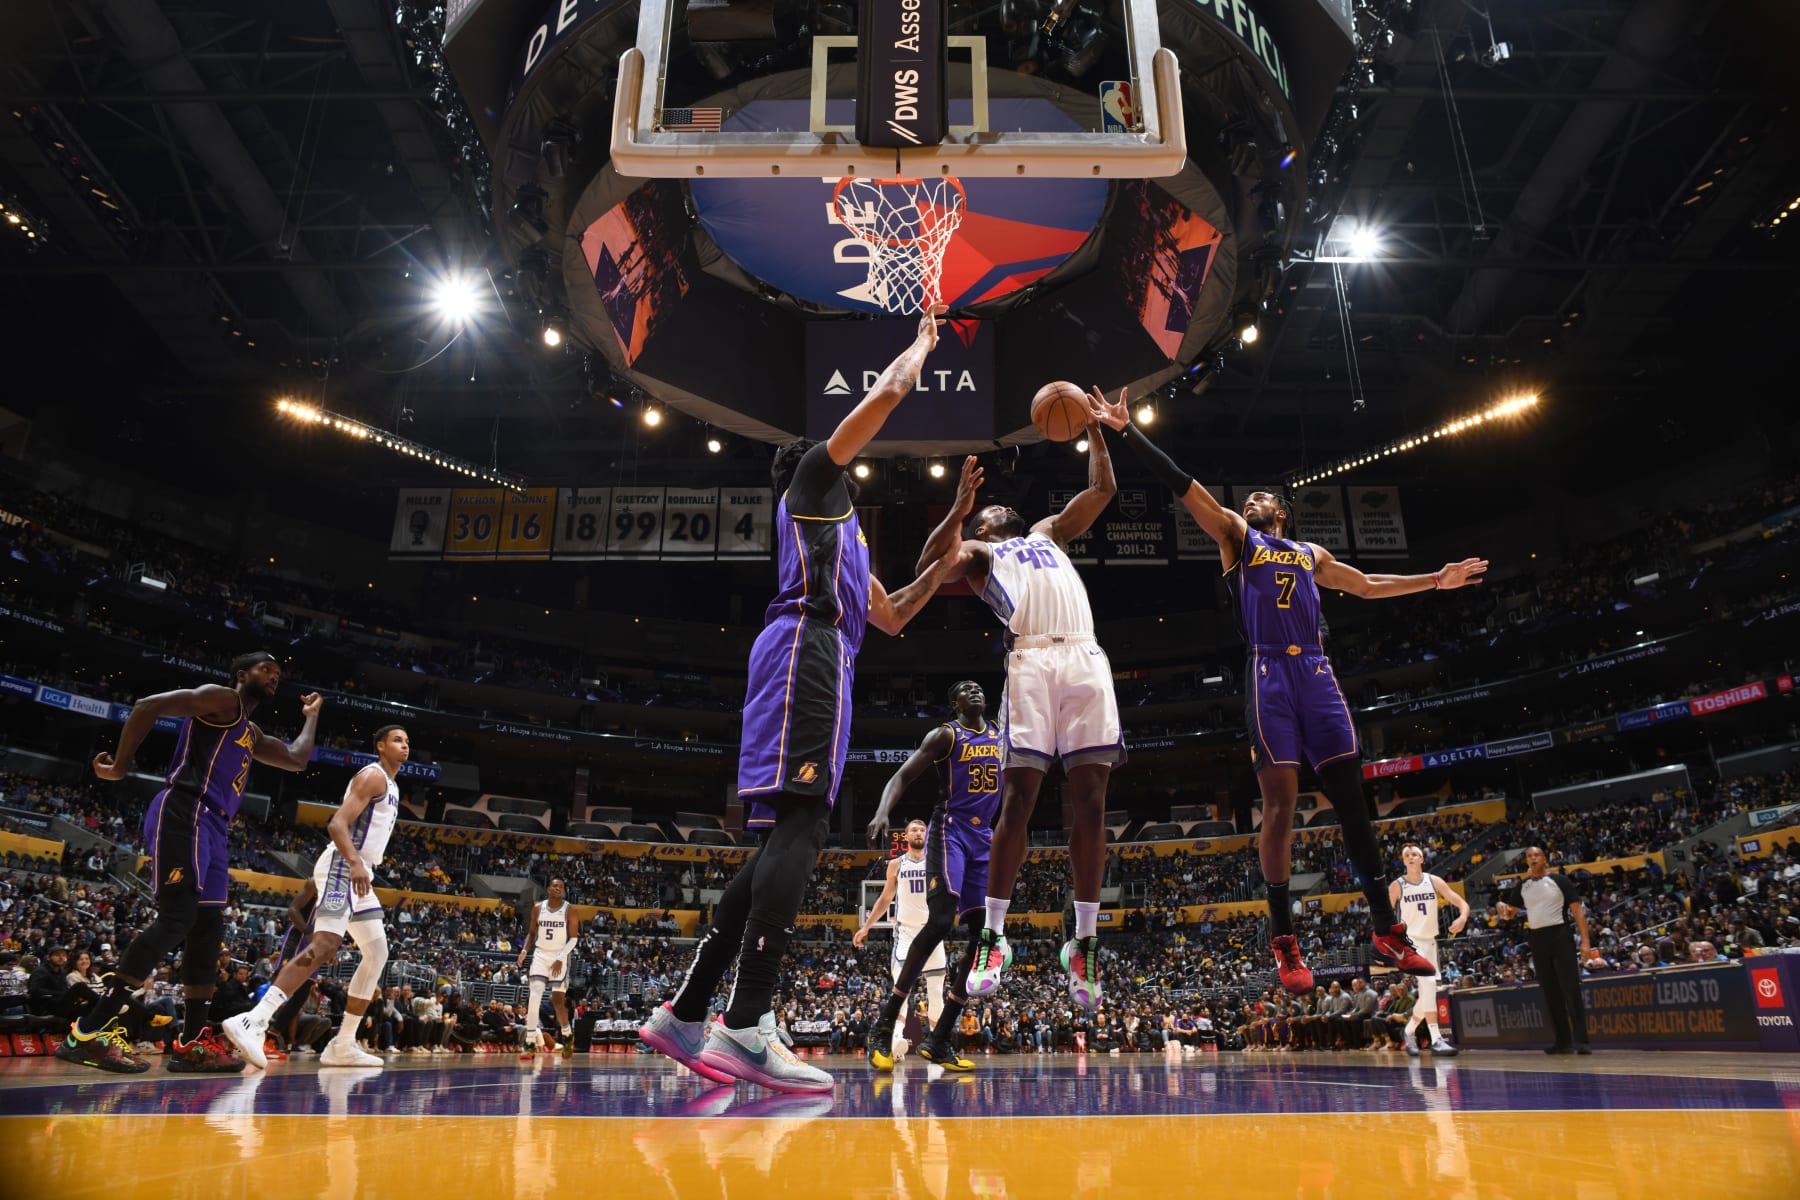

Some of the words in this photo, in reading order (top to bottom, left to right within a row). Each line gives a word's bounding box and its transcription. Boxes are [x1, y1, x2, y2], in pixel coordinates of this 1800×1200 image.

[895, 69, 919, 121] DWS
[863, 370, 976, 392] DLTA
[406, 495, 442, 505] MILLER
[616, 495, 659, 504] GRETZKY
[668, 495, 716, 505] ROBITAILLE
[730, 495, 763, 505] BLAKE
[453, 513, 493, 541] 30
[511, 512, 541, 541] 16
[565, 512, 597, 541] 18
[615, 512, 657, 540] 99
[670, 513, 711, 541] 20
[734, 512, 754, 540] 4
[1106, 522, 1144, 531] STANLEY
[1148, 522, 1162, 531] CUP
[1106, 531, 1163, 541] CHAMPIONS
[1116, 544, 1156, 555] 2011-12
[1015, 547, 1059, 570] 40
[1247, 545, 1313, 571] LAKERS
[1274, 571, 1296, 609] 7
[162, 653, 176, 665] LA
[178, 658, 202, 672] Hoops
[1576, 663, 1590, 674] LA
[44, 689, 67, 705] UCLA
[71, 697, 106, 715] Health
[336, 695, 349, 705] LA
[351, 698, 373, 711] Hoops
[1692, 685, 1762, 712] TOSHIBA
[1408, 702, 1420, 712] LA
[1655, 706, 1689, 720] ULTRA
[496, 723, 508, 732] LA
[509, 726, 530, 736] Hoops
[650, 741, 662, 749] LA
[958, 742, 1001, 762] LAKER
[880, 751, 909, 762] 9:56
[1440, 748, 1482, 763] DELTA
[232, 754, 250, 797] 2
[399, 764, 436, 777] DELTA
[967, 763, 999, 793] 35
[650, 845, 686, 857] LOS
[889, 841, 910, 858] 24
[900, 869, 926, 878] KING
[909, 879, 925, 894] 10
[1404, 892, 1436, 903] KINGS
[538, 920, 565, 928] KINGS
[545, 928, 554, 941] 5
[1320, 965, 1357, 976] CHAMPIONS
[1593, 984, 1655, 1009] DISCOVERY
[1656, 980, 1699, 1006] LEADS
[1700, 978, 1720, 1003] TO
[1464, 1008, 1492, 1028] UCLA
[1498, 1001, 1544, 1030] Health
[1638, 1010, 1685, 1034] HEALTH
[1687, 1007, 1726, 1033] CARE
[1756, 1015, 1794, 1027] TOYOTA
